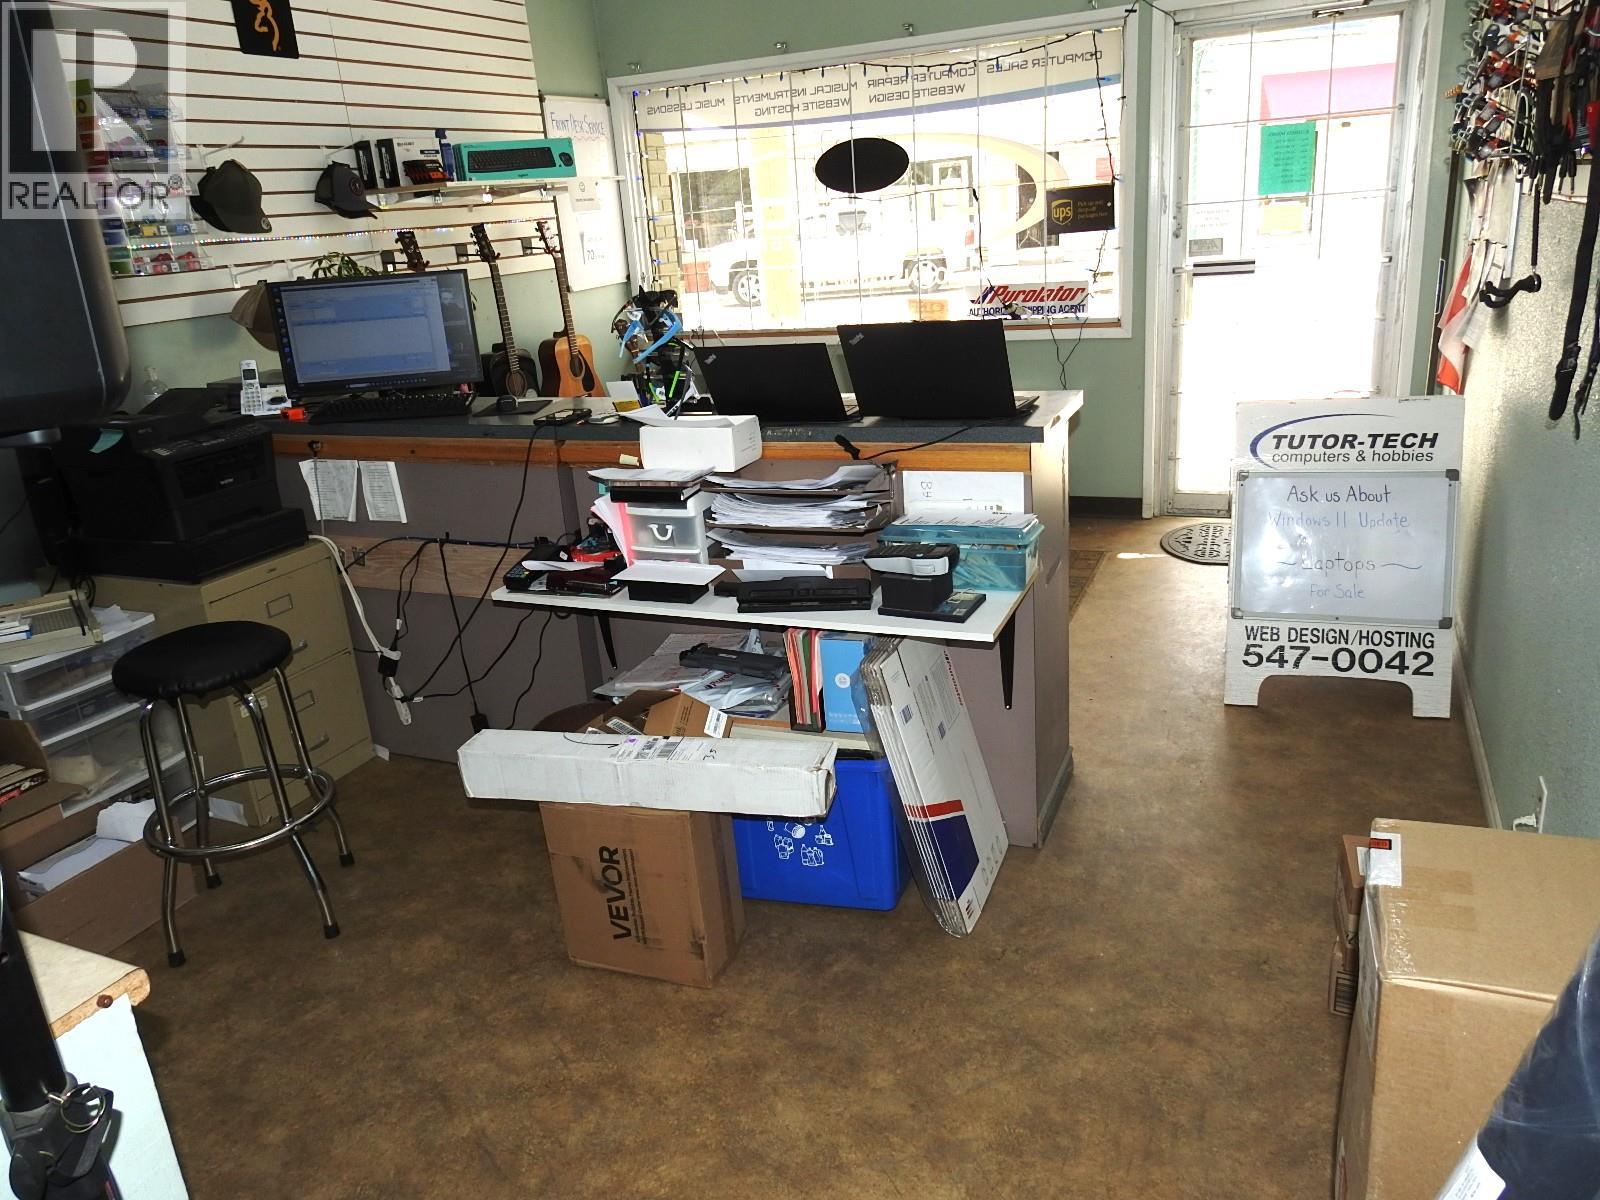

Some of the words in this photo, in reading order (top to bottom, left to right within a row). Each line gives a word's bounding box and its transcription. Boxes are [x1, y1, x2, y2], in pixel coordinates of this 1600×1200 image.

[1053, 207, 1072, 221] ups
[987, 285, 1086, 304] Purolator
[1272, 432, 1439, 450] TUTOR-TECH
[1272, 450, 1350, 465] computers
[1355, 451, 1367, 462] &
[1372, 449, 1434, 462] hobbies
[1287, 484, 1318, 503] Ask
[1325, 491, 1341, 503] us
[1346, 484, 1392, 503] About
[1268, 511, 1330, 528] Windows
[1359, 511, 1410, 530] Update
[1310, 584, 1328, 599] For
[1333, 584, 1366, 599] Sale
[1244, 625, 1280, 642] WEB
[1287, 627, 1435, 649] DESIGN/HOSTING
[1242, 643, 1435, 677] 547-0042
[599, 846, 632, 940] VEVOR
